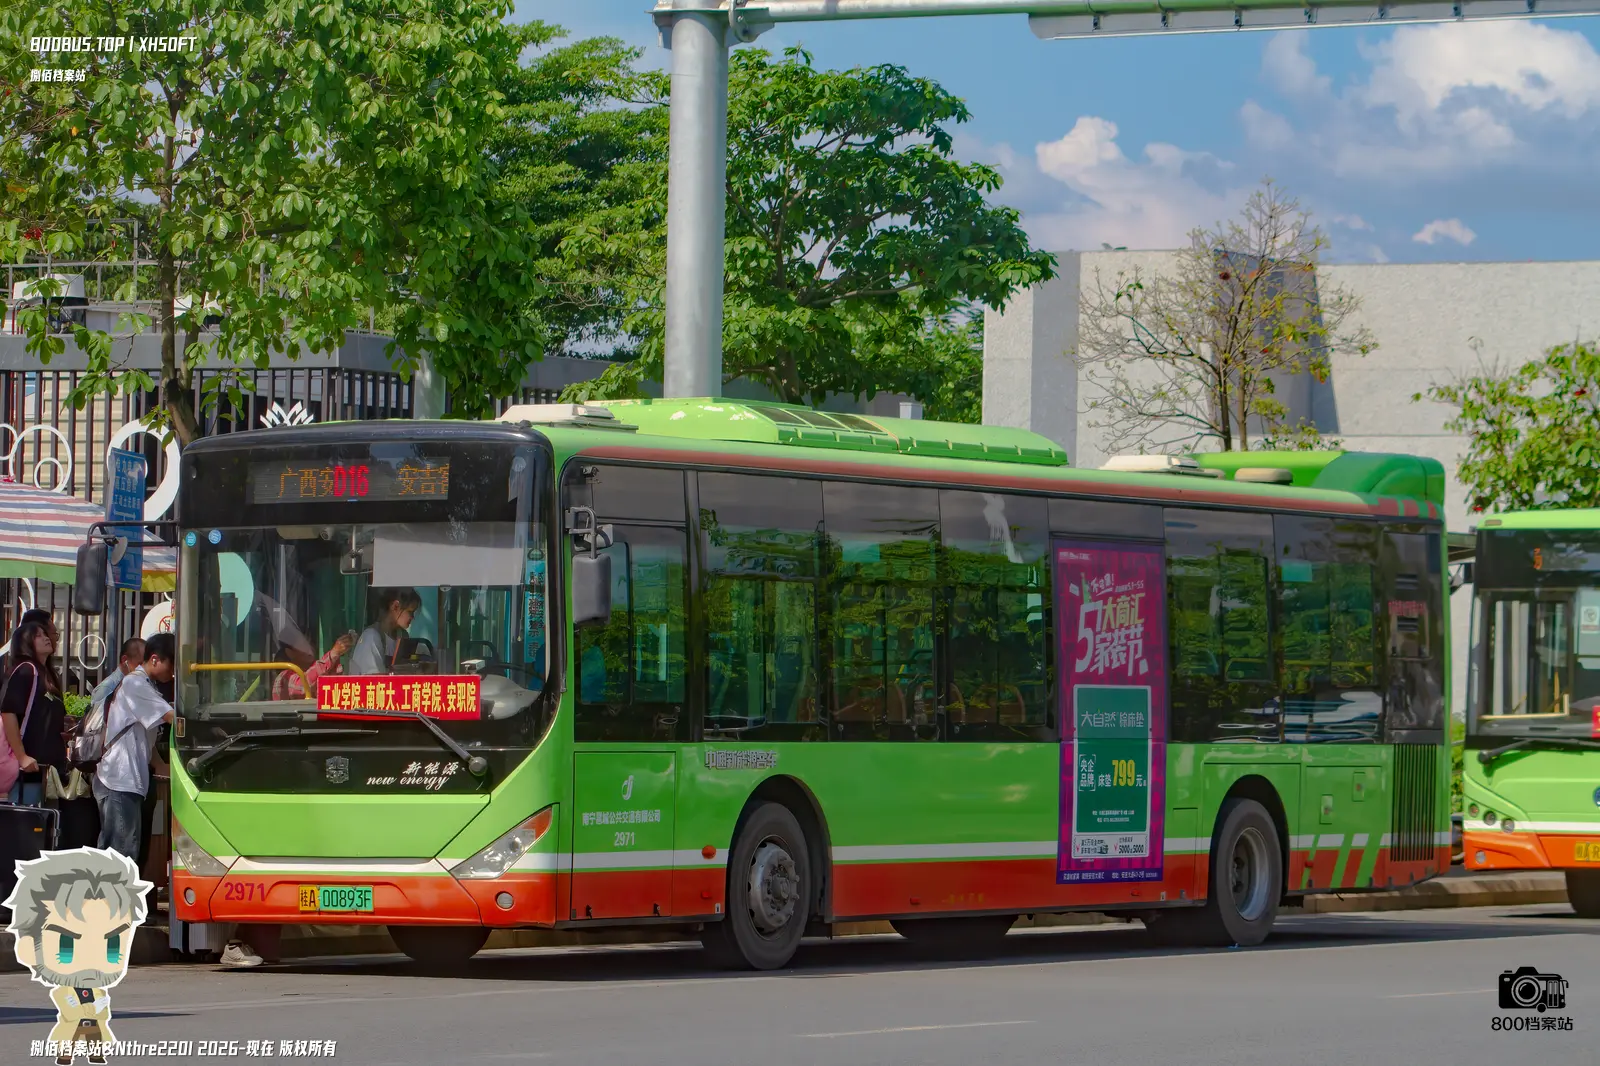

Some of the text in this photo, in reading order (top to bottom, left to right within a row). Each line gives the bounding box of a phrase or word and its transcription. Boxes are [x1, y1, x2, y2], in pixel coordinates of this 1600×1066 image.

[333, 465, 369, 497] D16
[1090, 624, 1144, 676] 家装节
[402, 761, 459, 776] 新能源
[366, 776, 449, 790] new energy
[614, 832, 635, 846] 2971
[224, 882, 266, 901] 2971
[300, 889, 371, 908] 桂A 00893F
